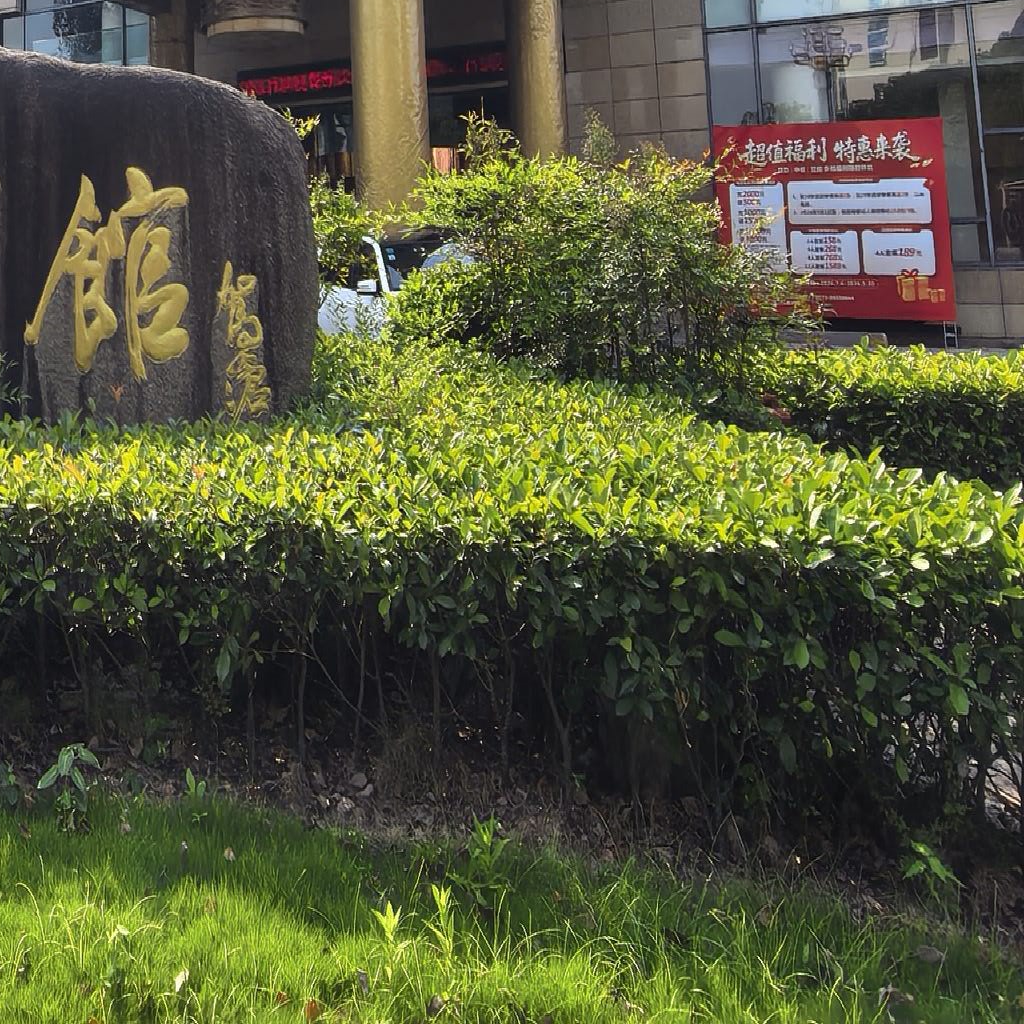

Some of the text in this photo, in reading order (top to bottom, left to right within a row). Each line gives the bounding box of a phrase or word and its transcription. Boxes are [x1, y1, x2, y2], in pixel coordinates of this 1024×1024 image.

[740, 131, 916, 166] 超值福利 特惠来袭
